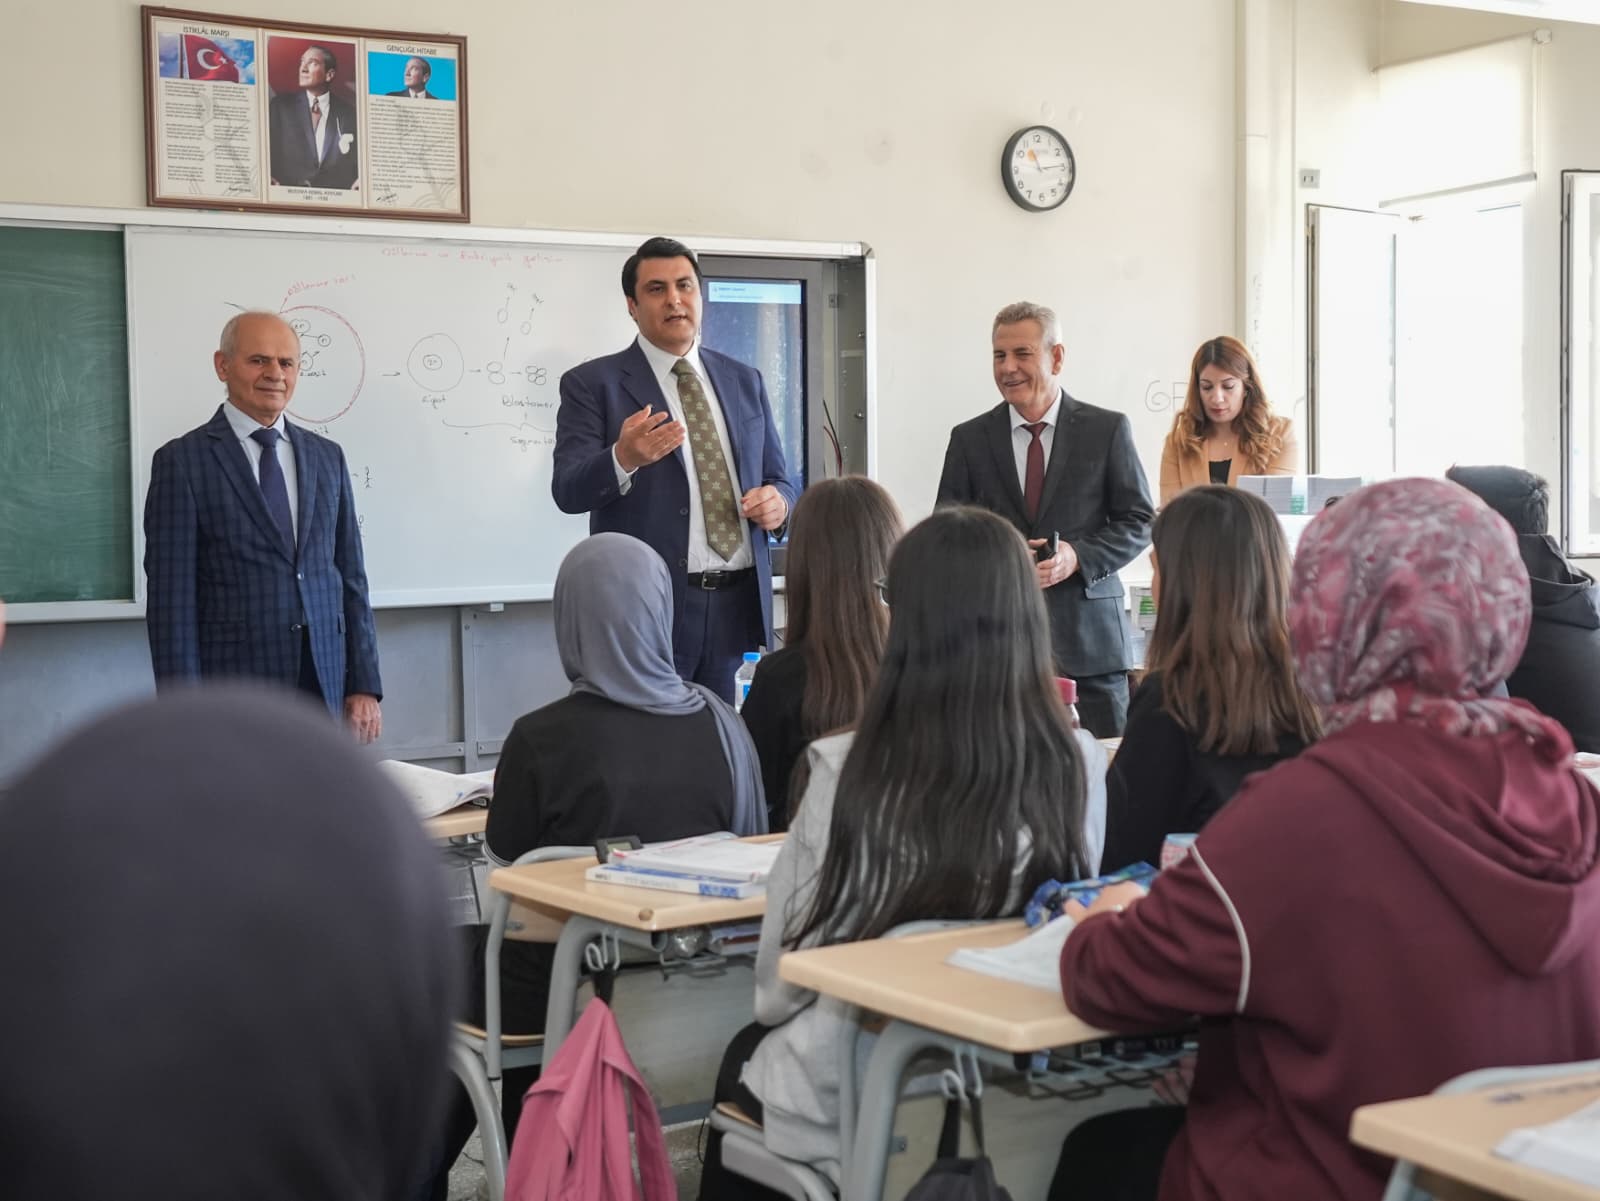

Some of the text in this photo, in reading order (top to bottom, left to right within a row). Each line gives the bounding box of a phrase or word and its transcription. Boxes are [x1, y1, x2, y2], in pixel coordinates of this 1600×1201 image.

[1033, 134, 1041, 143] 12
[1015, 150, 1025, 158] 10
[1014, 166, 1019, 175] 9
[1017, 180, 1024, 189] 8
[1025, 189, 1032, 199] 7
[1039, 192, 1045, 202] 6
[1050, 188, 1057, 197] 5
